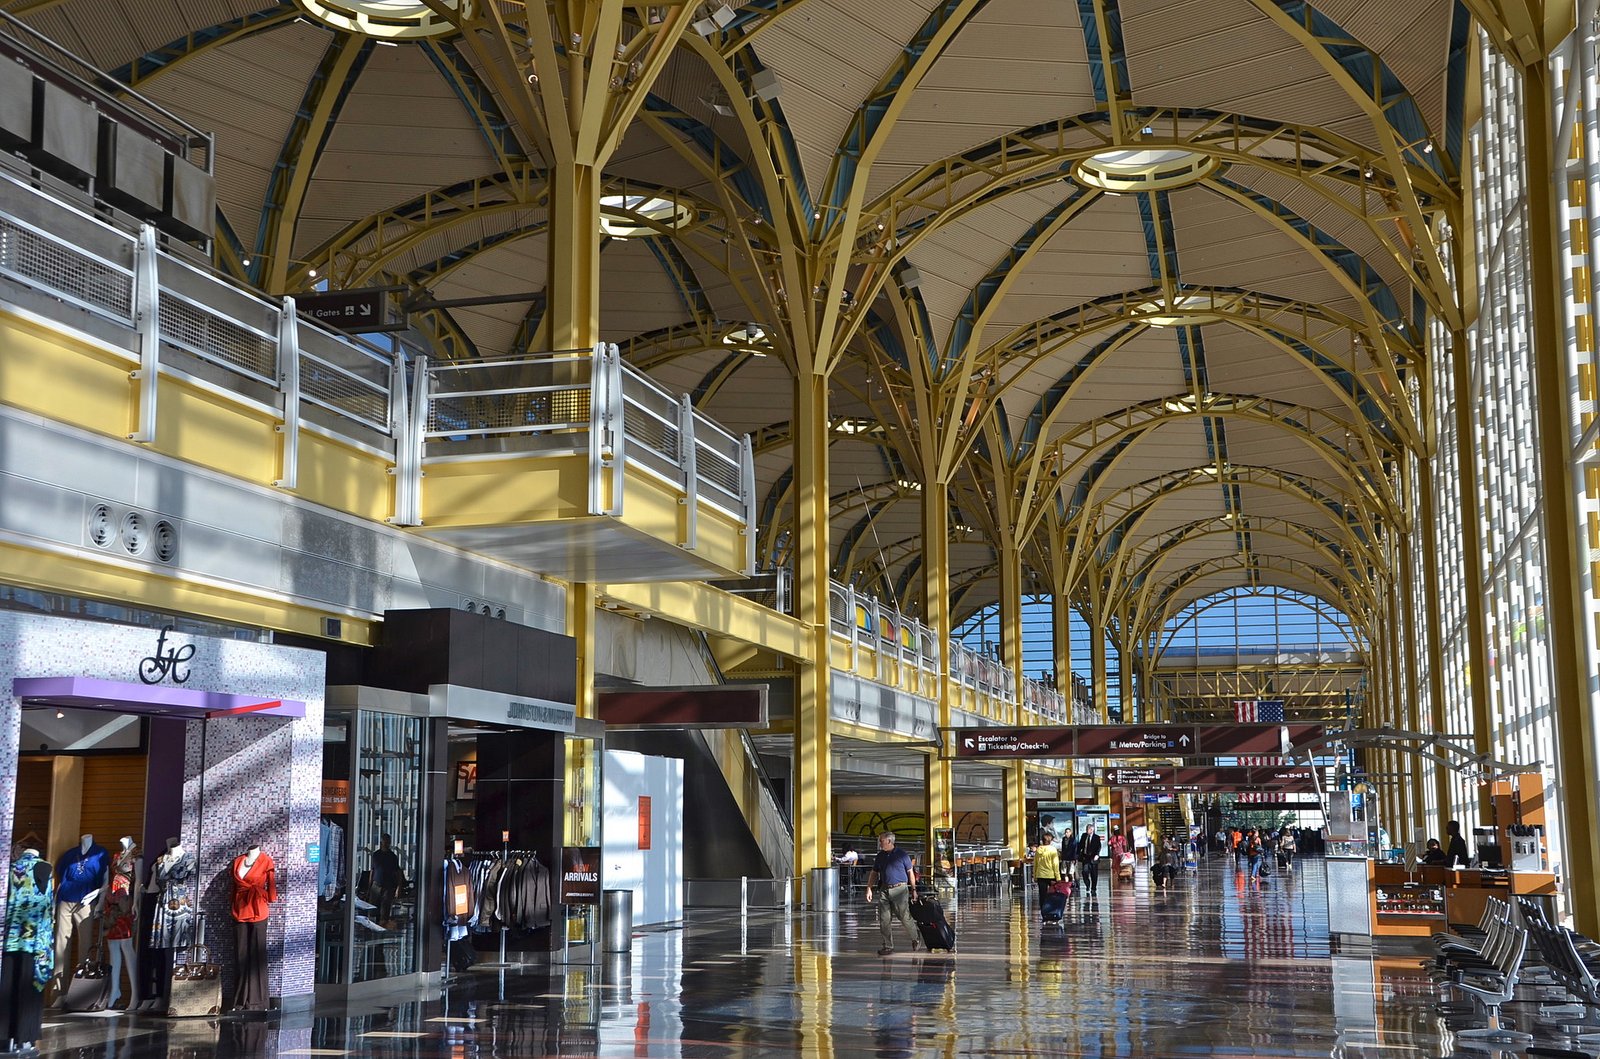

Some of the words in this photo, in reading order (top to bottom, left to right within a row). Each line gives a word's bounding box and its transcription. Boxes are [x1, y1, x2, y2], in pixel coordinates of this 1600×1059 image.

[316, 309, 341, 317] Gates
[987, 743, 1049, 751] Ticketing/Check-In
[1119, 741, 1167, 749] Metro/Parking
[573, 864, 590, 872] NEW
[564, 872, 598, 882] ARRIVALS
